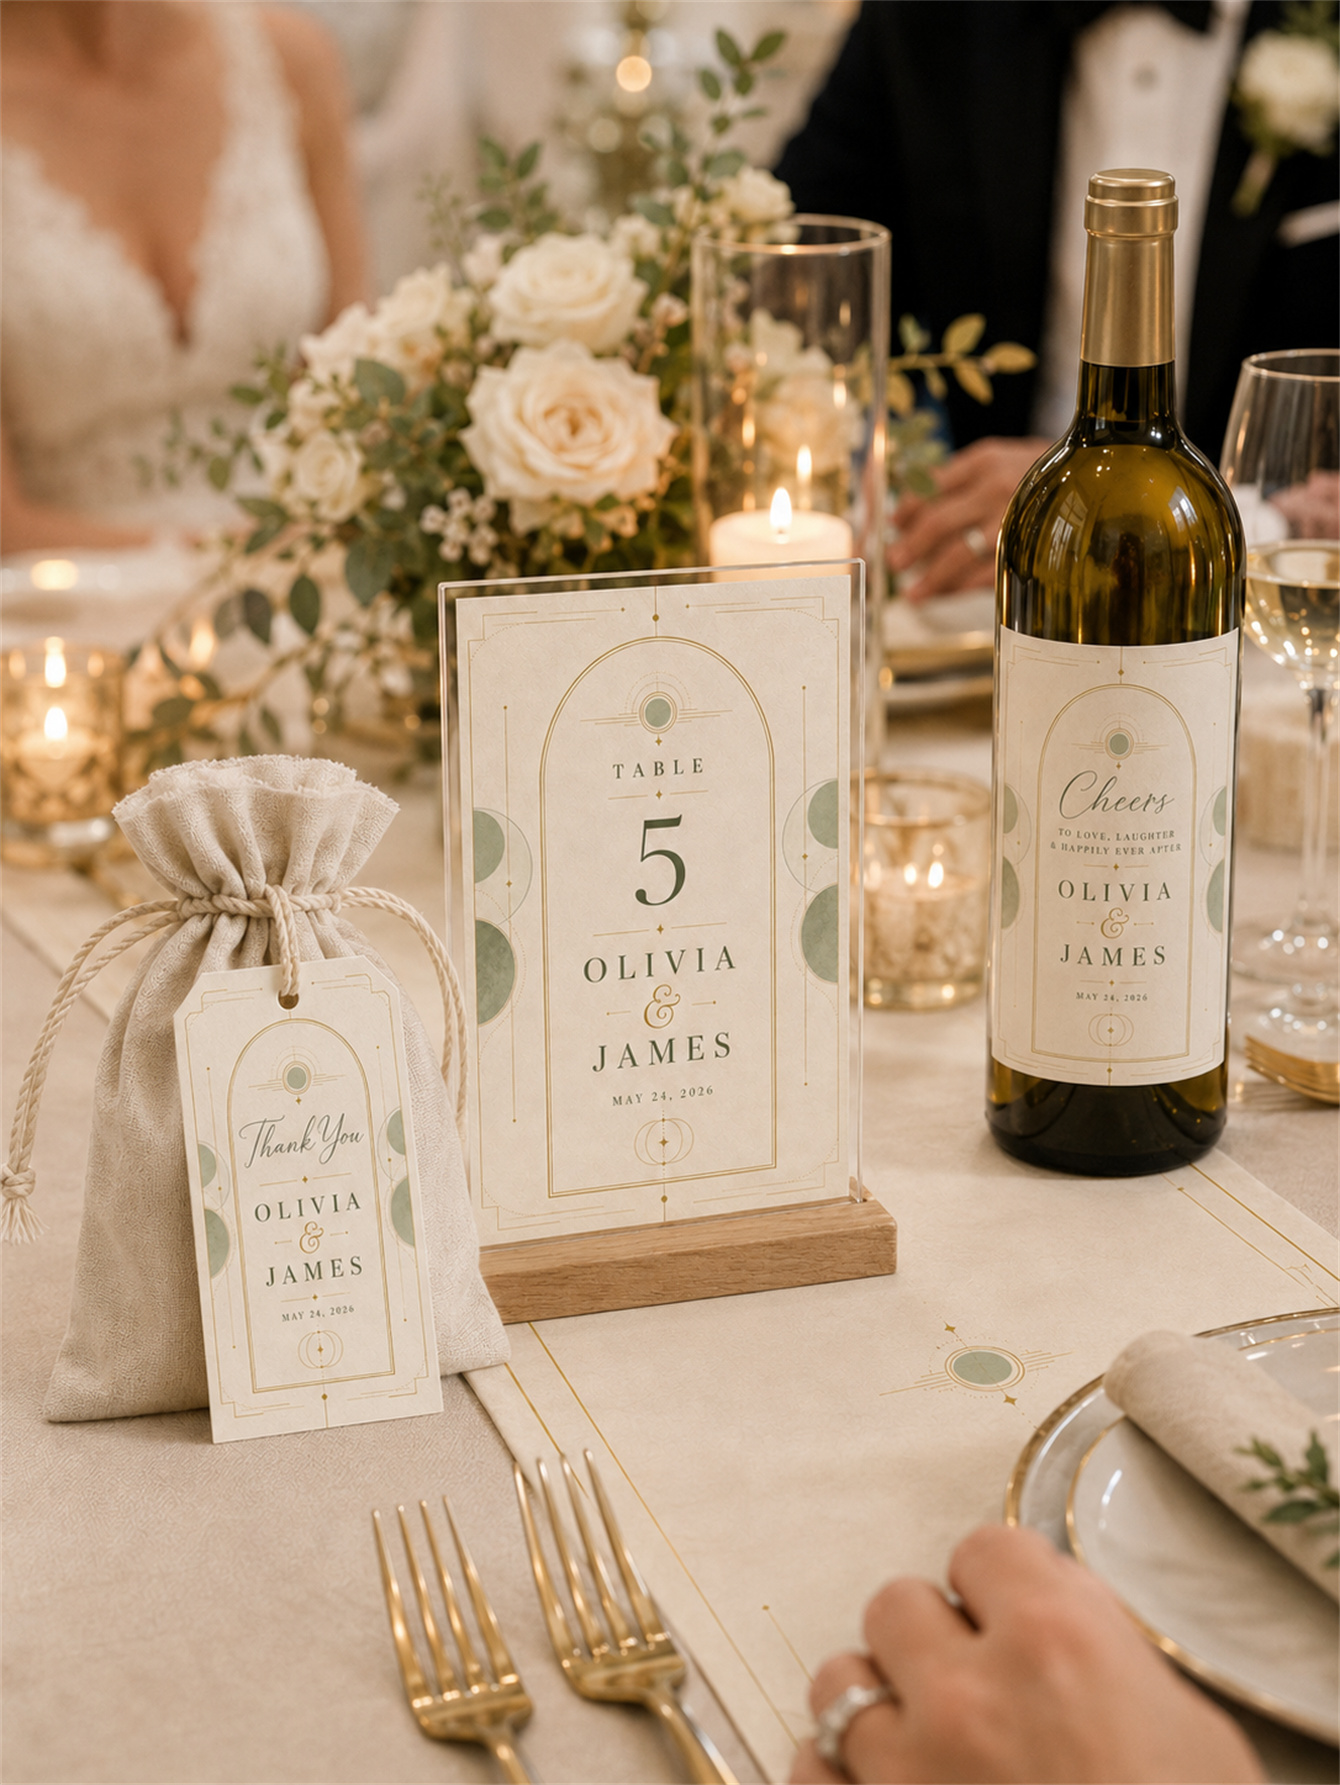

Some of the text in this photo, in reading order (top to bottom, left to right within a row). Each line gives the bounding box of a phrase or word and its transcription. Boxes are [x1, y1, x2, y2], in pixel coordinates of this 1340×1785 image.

[612, 757, 704, 779] TABLE
[1059, 770, 1175, 820] Cheers
[1058, 827, 1176, 841] TO LOVE, LAUGHTER
[1061, 842, 1110, 855] HAPPILY
[1115, 847, 1145, 856] EVER
[1149, 843, 1182, 855] AFTER
[635, 813, 686, 907] 5
[1058, 879, 1171, 902] OLIVIA
[1100, 907, 1130, 939] &
[583, 945, 736, 983] OLIVIA
[1060, 943, 1166, 967] JAMES
[643, 983, 681, 1029] &
[1075, 991, 1099, 1001] MAY
[1124, 992, 1148, 1002] 2026
[592, 1031, 731, 1073] JAMES
[611, 1084, 714, 1107] MAY 24, 2026
[238, 1112, 365, 1169] Thank You
[254, 1192, 361, 1222] OLIVIA
[299, 1221, 325, 1254] &
[266, 1255, 363, 1287] JAMES
[281, 1304, 355, 1322] MAY 24, 2026
